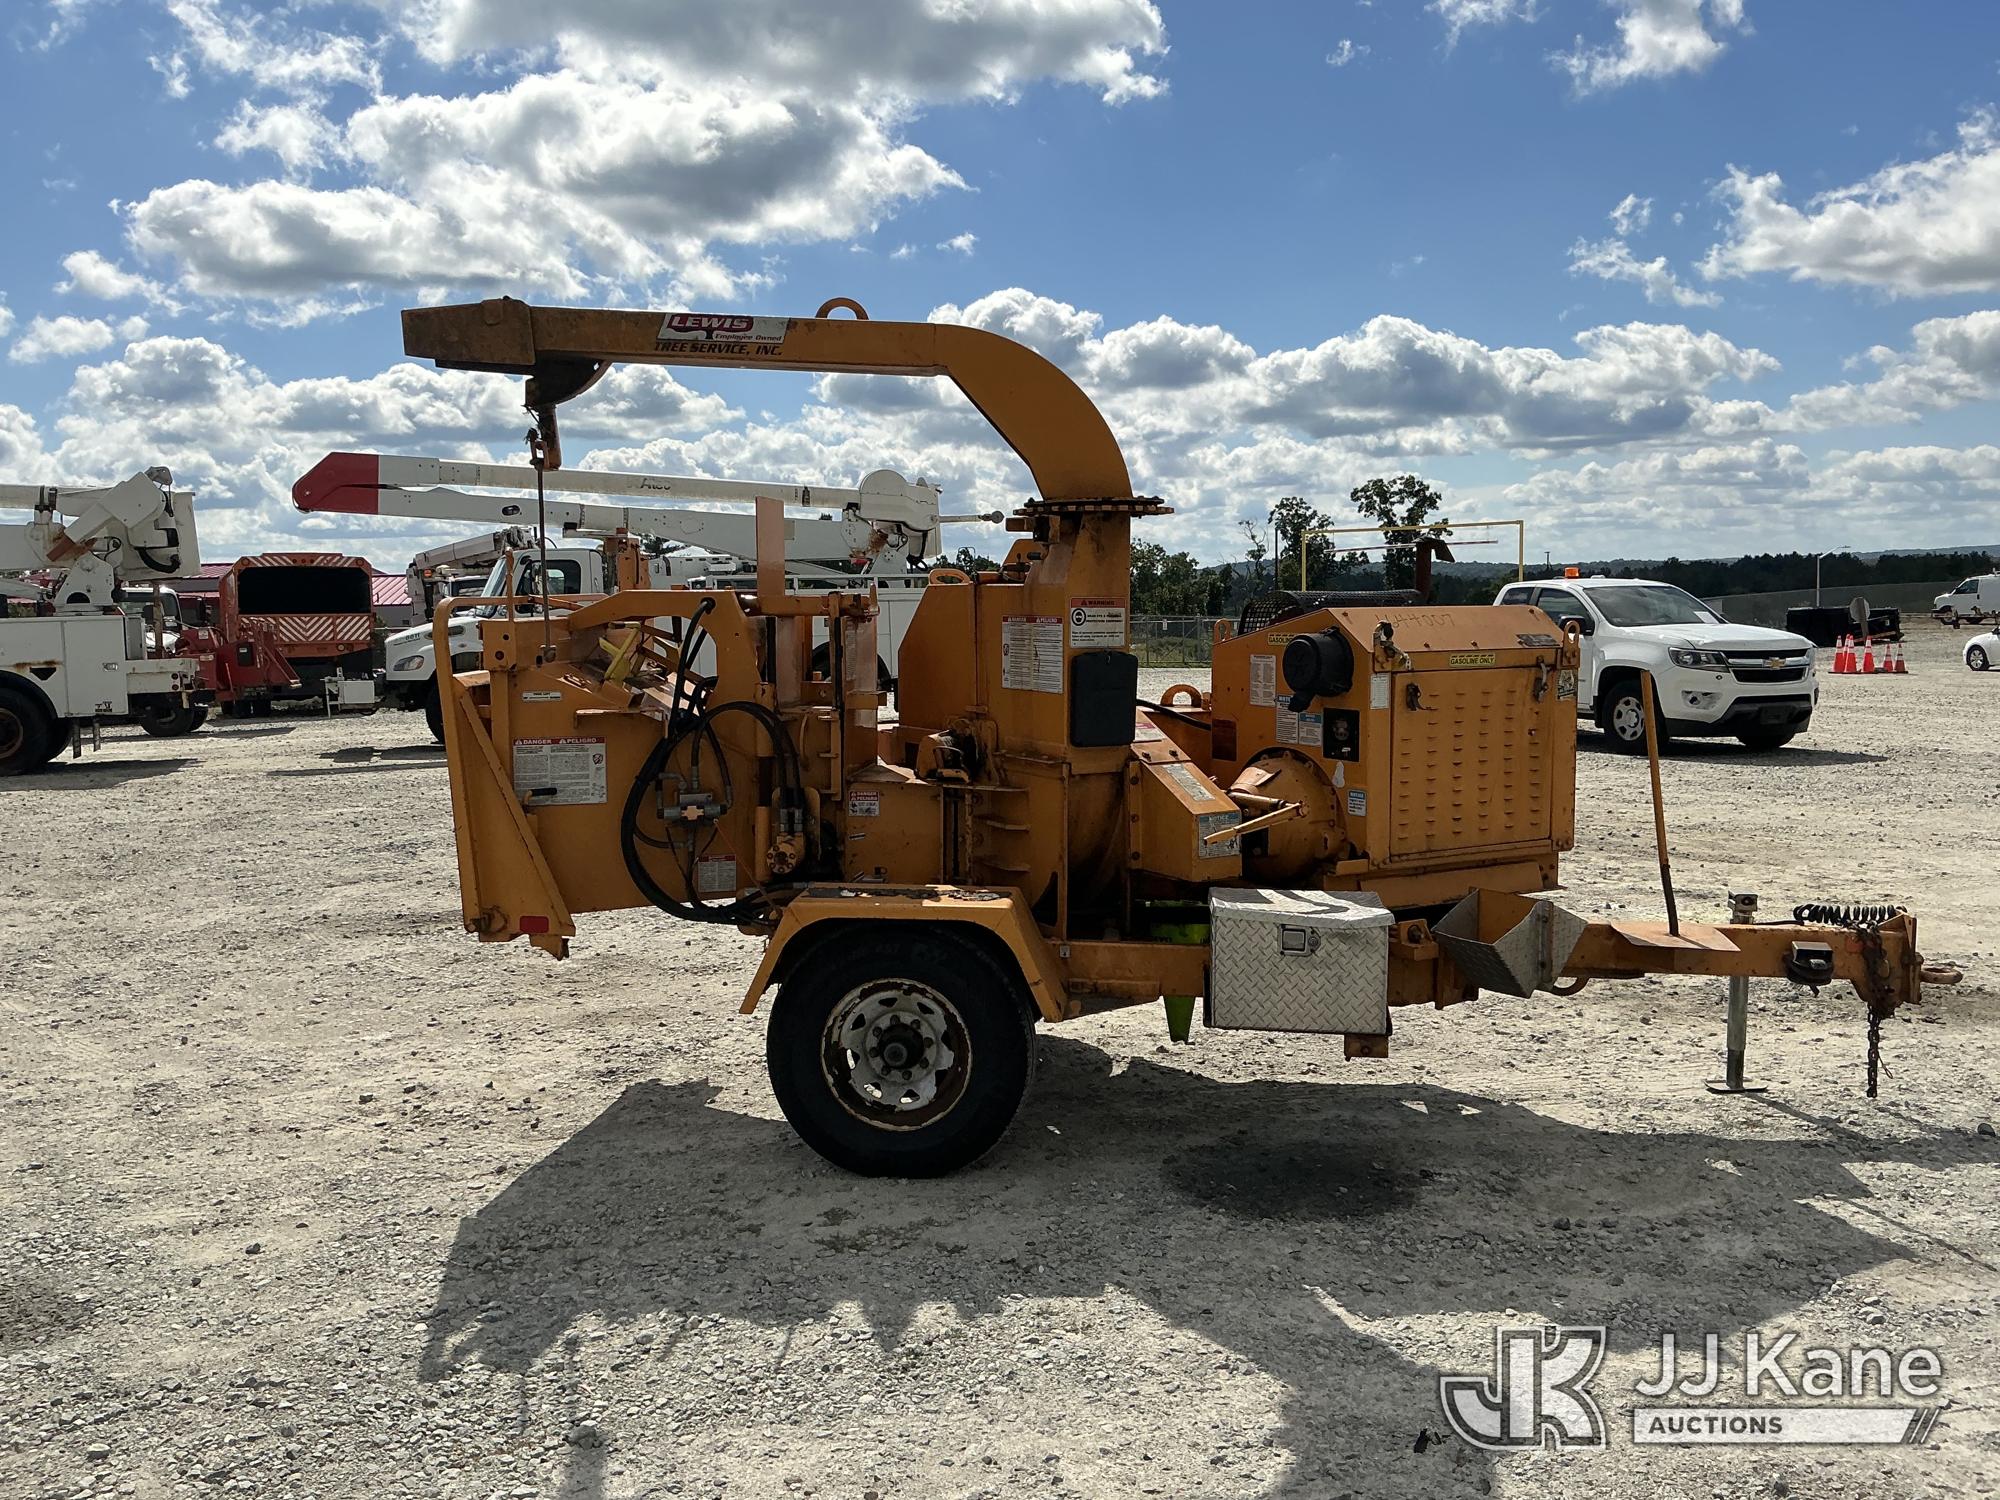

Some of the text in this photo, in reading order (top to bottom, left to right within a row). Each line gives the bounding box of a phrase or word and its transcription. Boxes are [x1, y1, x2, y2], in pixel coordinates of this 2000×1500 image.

[671, 316, 750, 329] LEWIS
[715, 333, 782, 342] Employee Owned
[654, 342, 782, 356] TREE SERVICE, INC.
